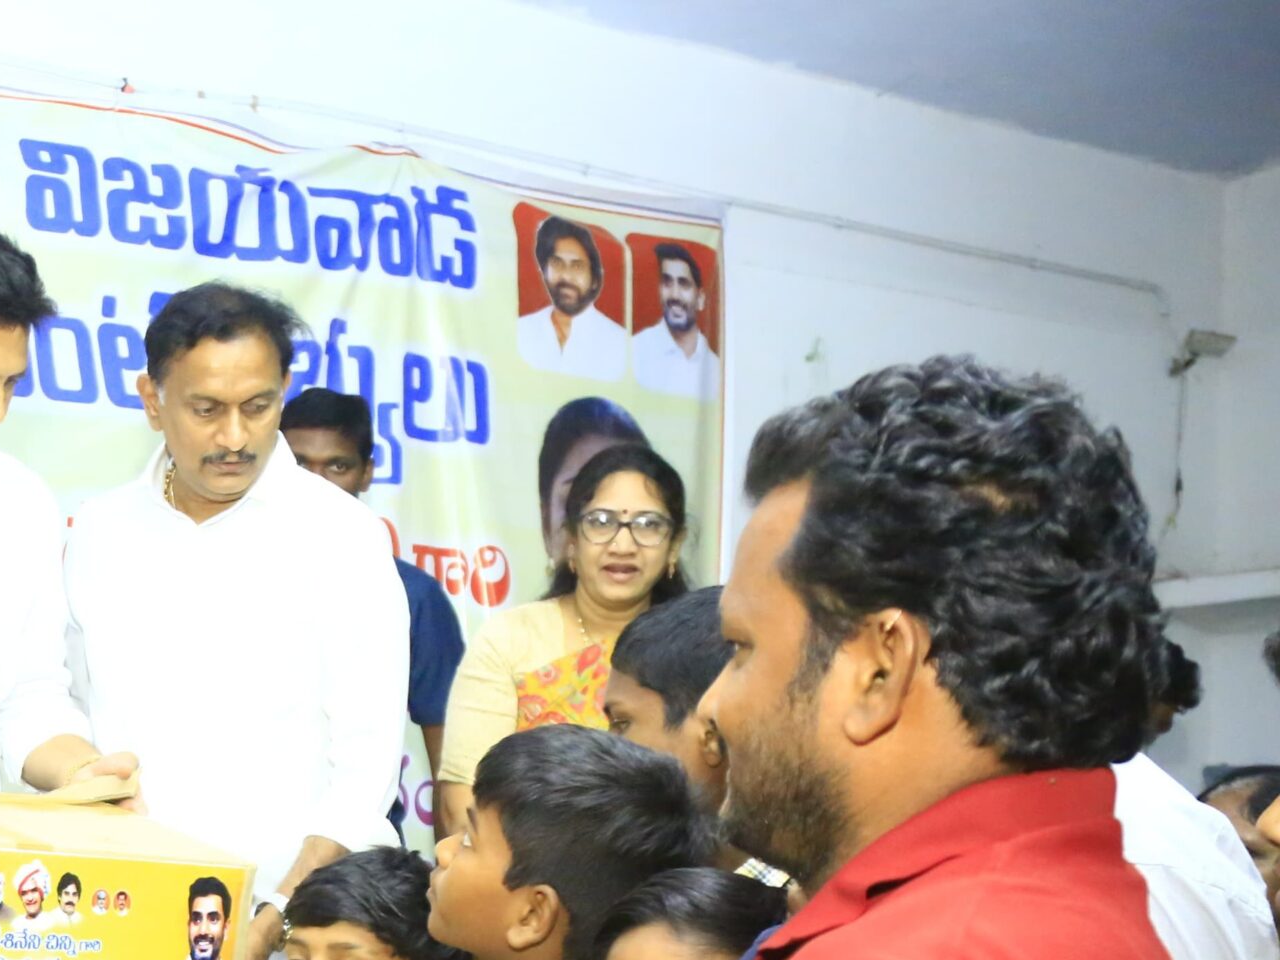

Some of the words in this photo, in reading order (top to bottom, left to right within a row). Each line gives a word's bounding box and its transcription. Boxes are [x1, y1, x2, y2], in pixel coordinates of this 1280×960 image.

[19, 137, 477, 290] విజయవాడ
[412, 543, 511, 608] గారి
[45, 933, 77, 956] చిన్ని
[79, 939, 101, 951] గారి
